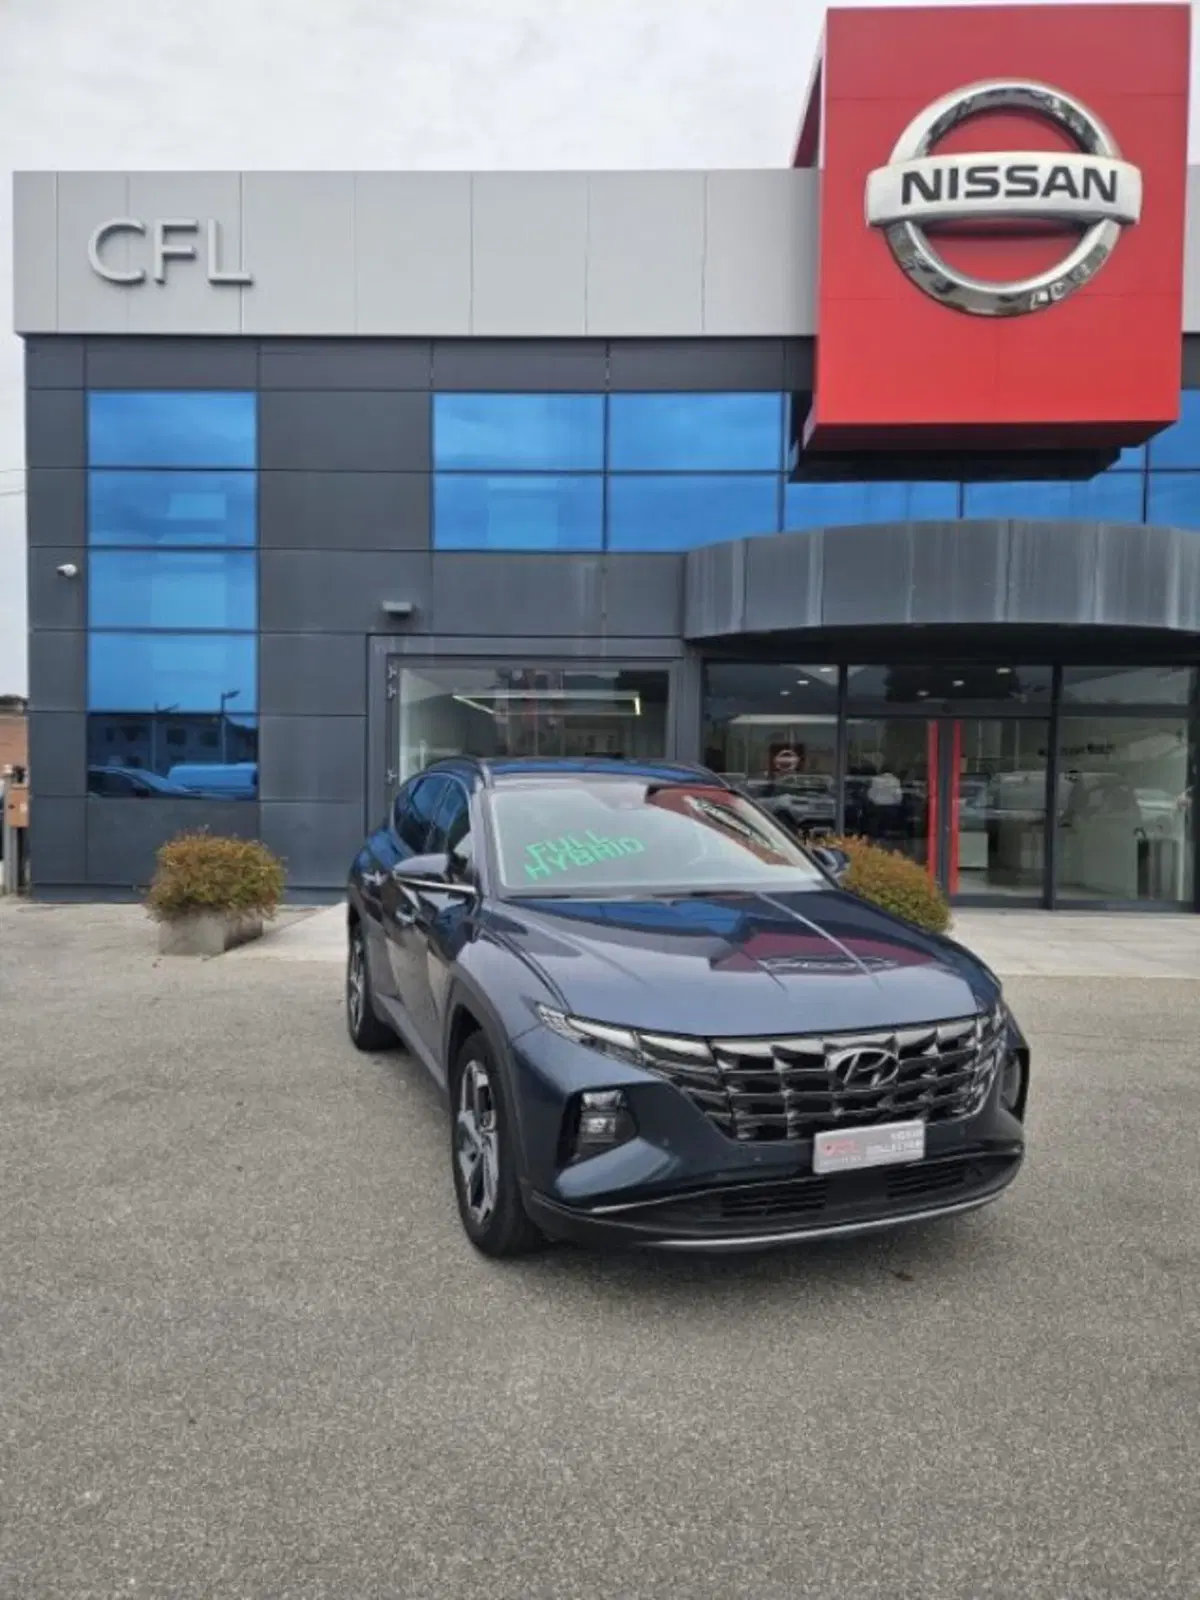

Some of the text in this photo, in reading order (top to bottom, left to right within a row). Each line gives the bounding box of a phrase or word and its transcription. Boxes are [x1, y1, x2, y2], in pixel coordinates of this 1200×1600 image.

[902, 165, 1118, 205] NISSAN
[88, 217, 253, 286] CFL
[524, 837, 646, 880] HYBRID
[525, 829, 610, 863] FULL
